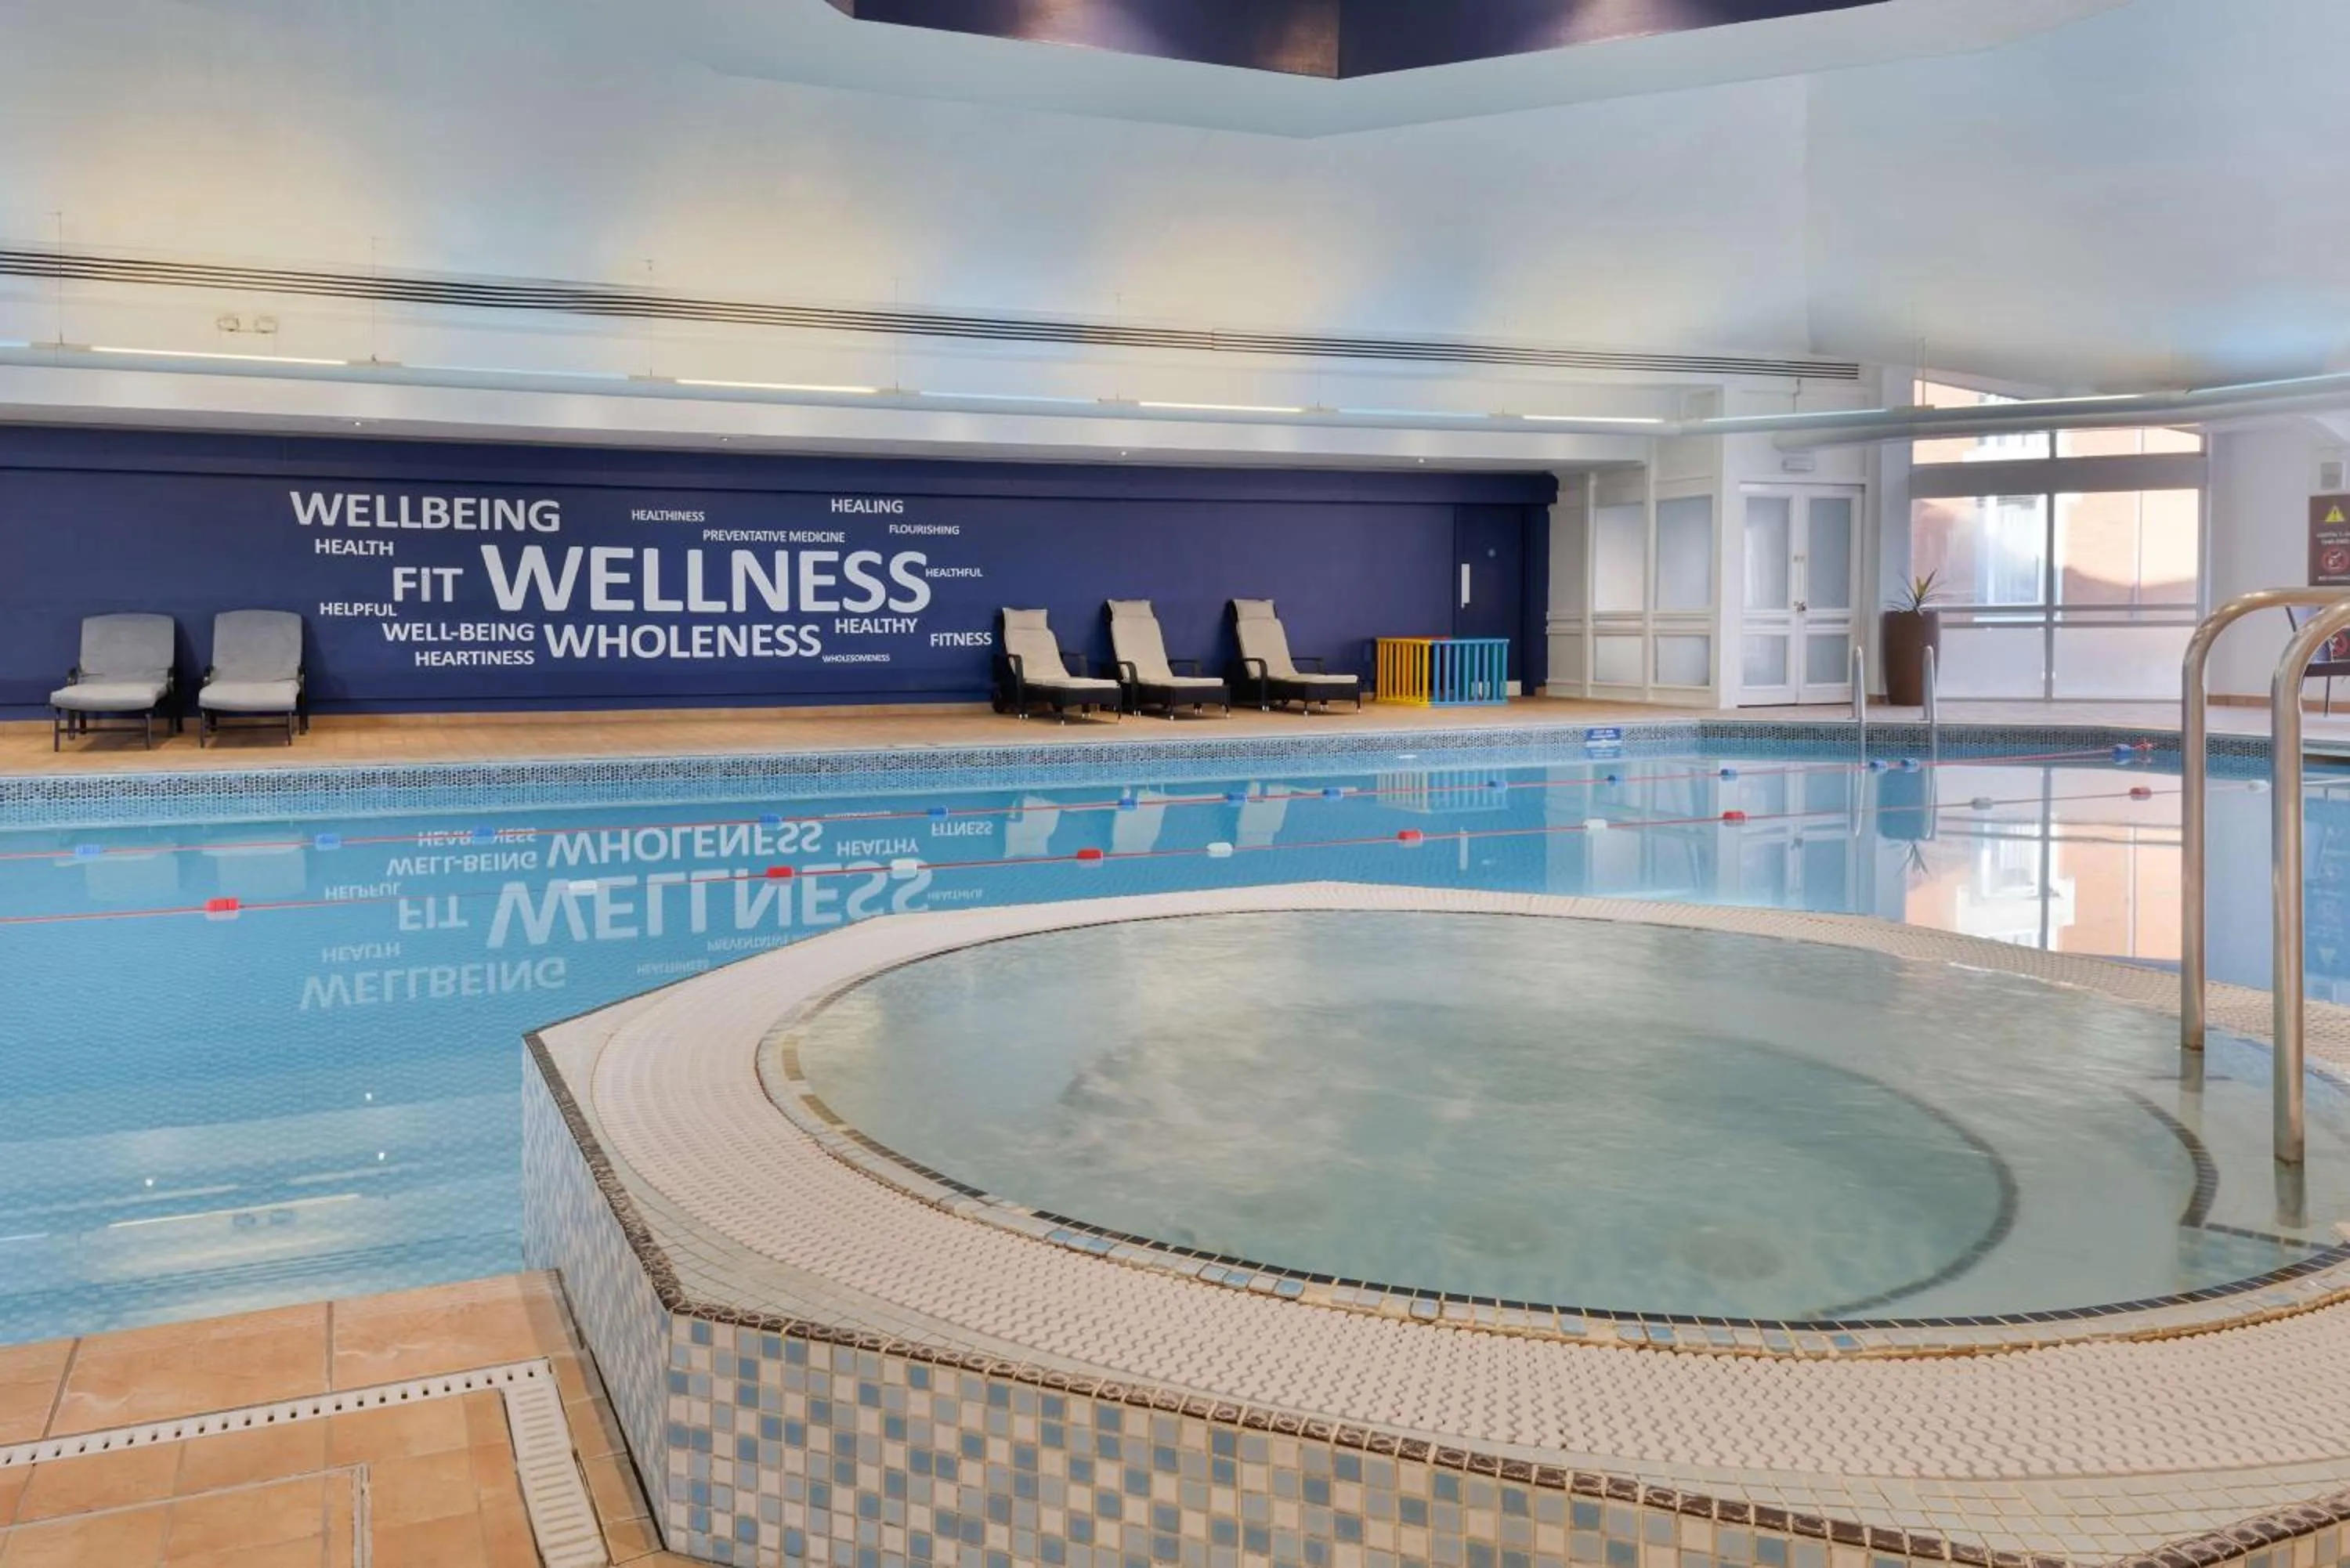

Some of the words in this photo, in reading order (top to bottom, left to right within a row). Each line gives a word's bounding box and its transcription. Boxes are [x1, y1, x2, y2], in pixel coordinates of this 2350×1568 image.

[289, 491, 561, 532] WELLBEING
[830, 499, 904, 514] HEALING
[631, 509, 705, 522] HEALTHINESS
[703, 529, 786, 542] PREVENTATIVE
[789, 531, 845, 543] MEDICINE
[889, 524, 960, 535] FLOURISHING
[314, 539, 394, 556] HEALTH
[480, 544, 931, 612] WELLNESS
[925, 568, 983, 577] HEALTHFUL
[392, 566, 464, 602] FIT
[319, 602, 397, 616] HELPFUL
[382, 623, 535, 642] WELL-BEING
[834, 618, 918, 634] HEALTHY
[544, 624, 822, 659] WHOLENESS
[930, 632, 992, 647] FITNESS
[414, 650, 535, 667] HEARTINESS
[822, 654, 891, 663] WHOLESOMENESS
